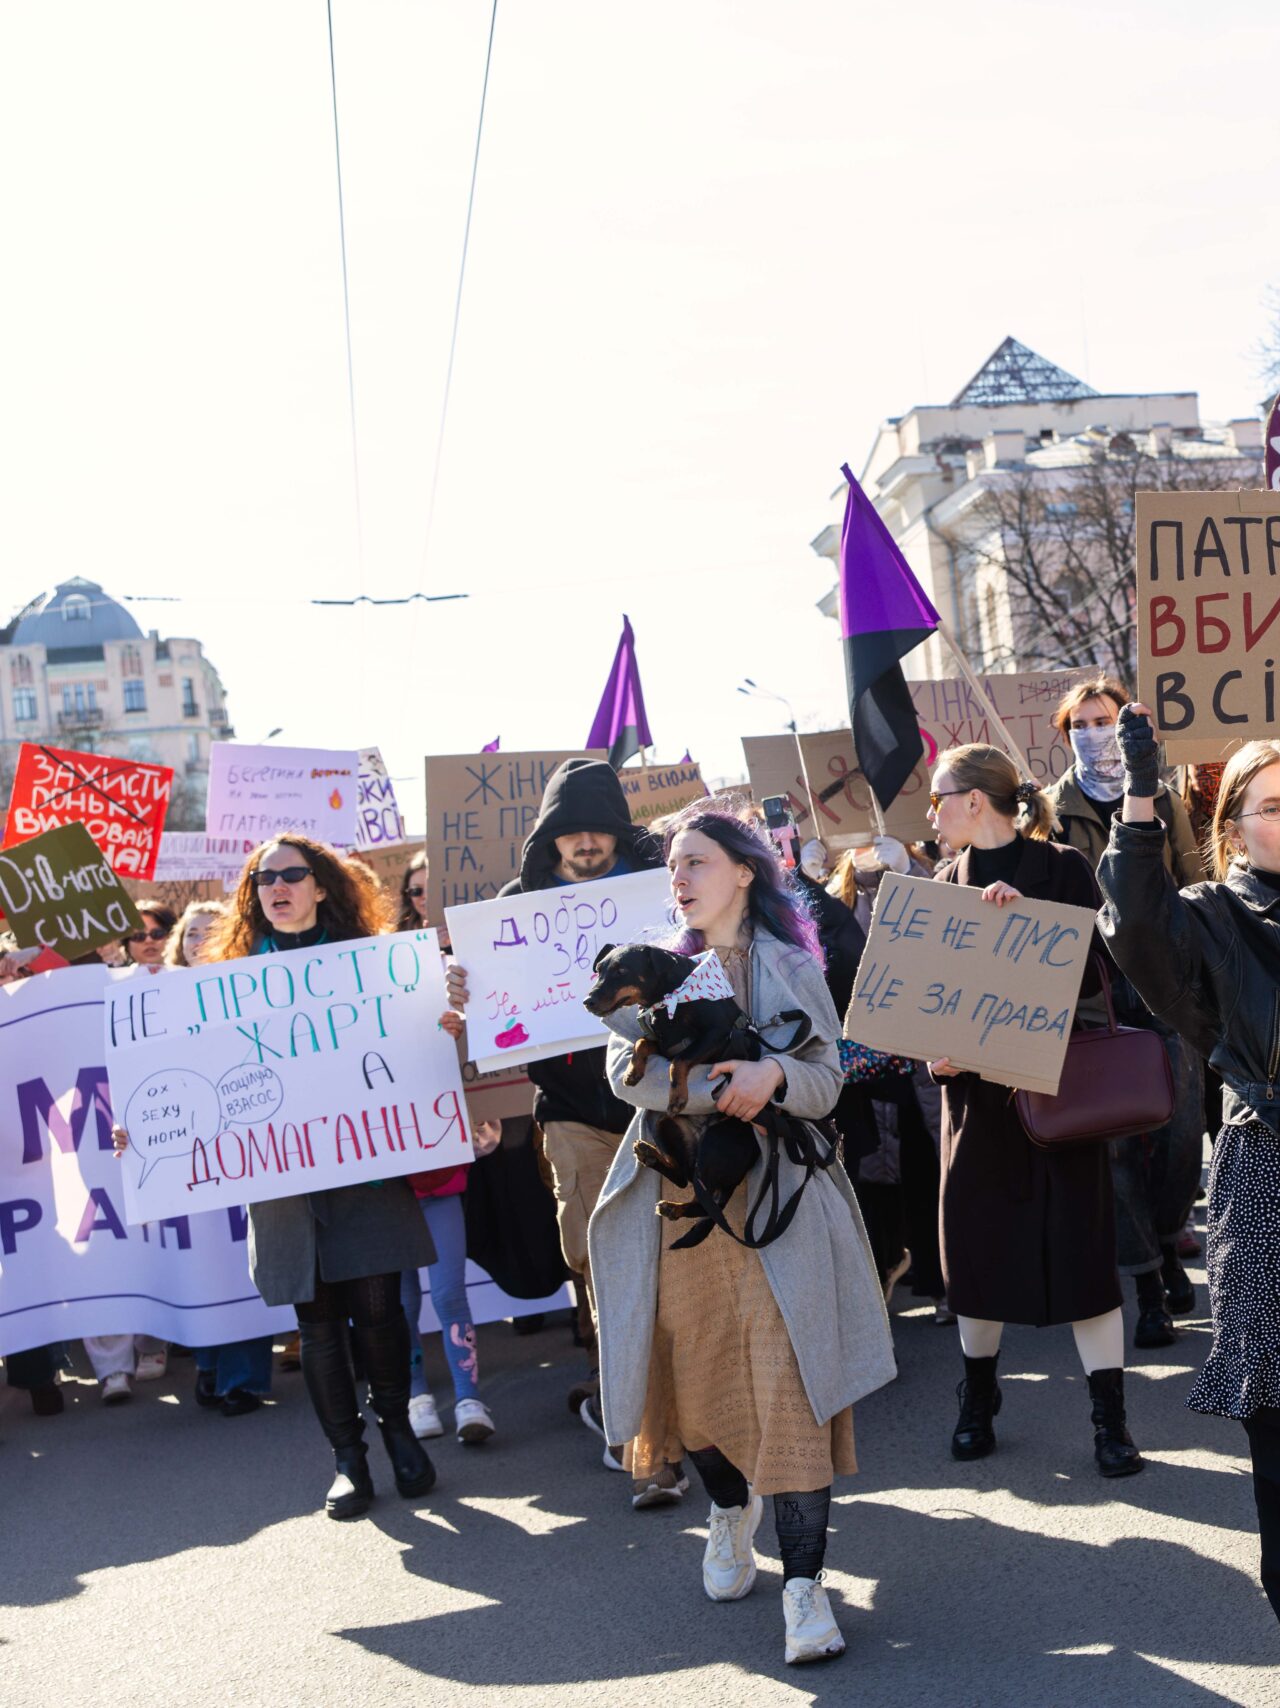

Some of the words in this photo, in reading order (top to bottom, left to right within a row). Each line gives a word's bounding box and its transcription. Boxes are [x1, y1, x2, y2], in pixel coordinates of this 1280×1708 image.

[33, 754, 170, 802] ЗАХИСТИ
[443, 811, 483, 841] НЕ
[500, 805, 539, 838] ПР
[879, 886, 933, 942] ЦЕ
[941, 915, 981, 950] НЕ
[992, 913, 1079, 966] ПМС
[110, 989, 168, 1047] НЕ
[857, 963, 904, 1012] ЦЕ
[918, 983, 962, 1016] ЗА
[970, 993, 1070, 1046] ПРАВА
[362, 1051, 395, 1090] А
[186, 1090, 468, 1191] ДОМАГАННЯ
